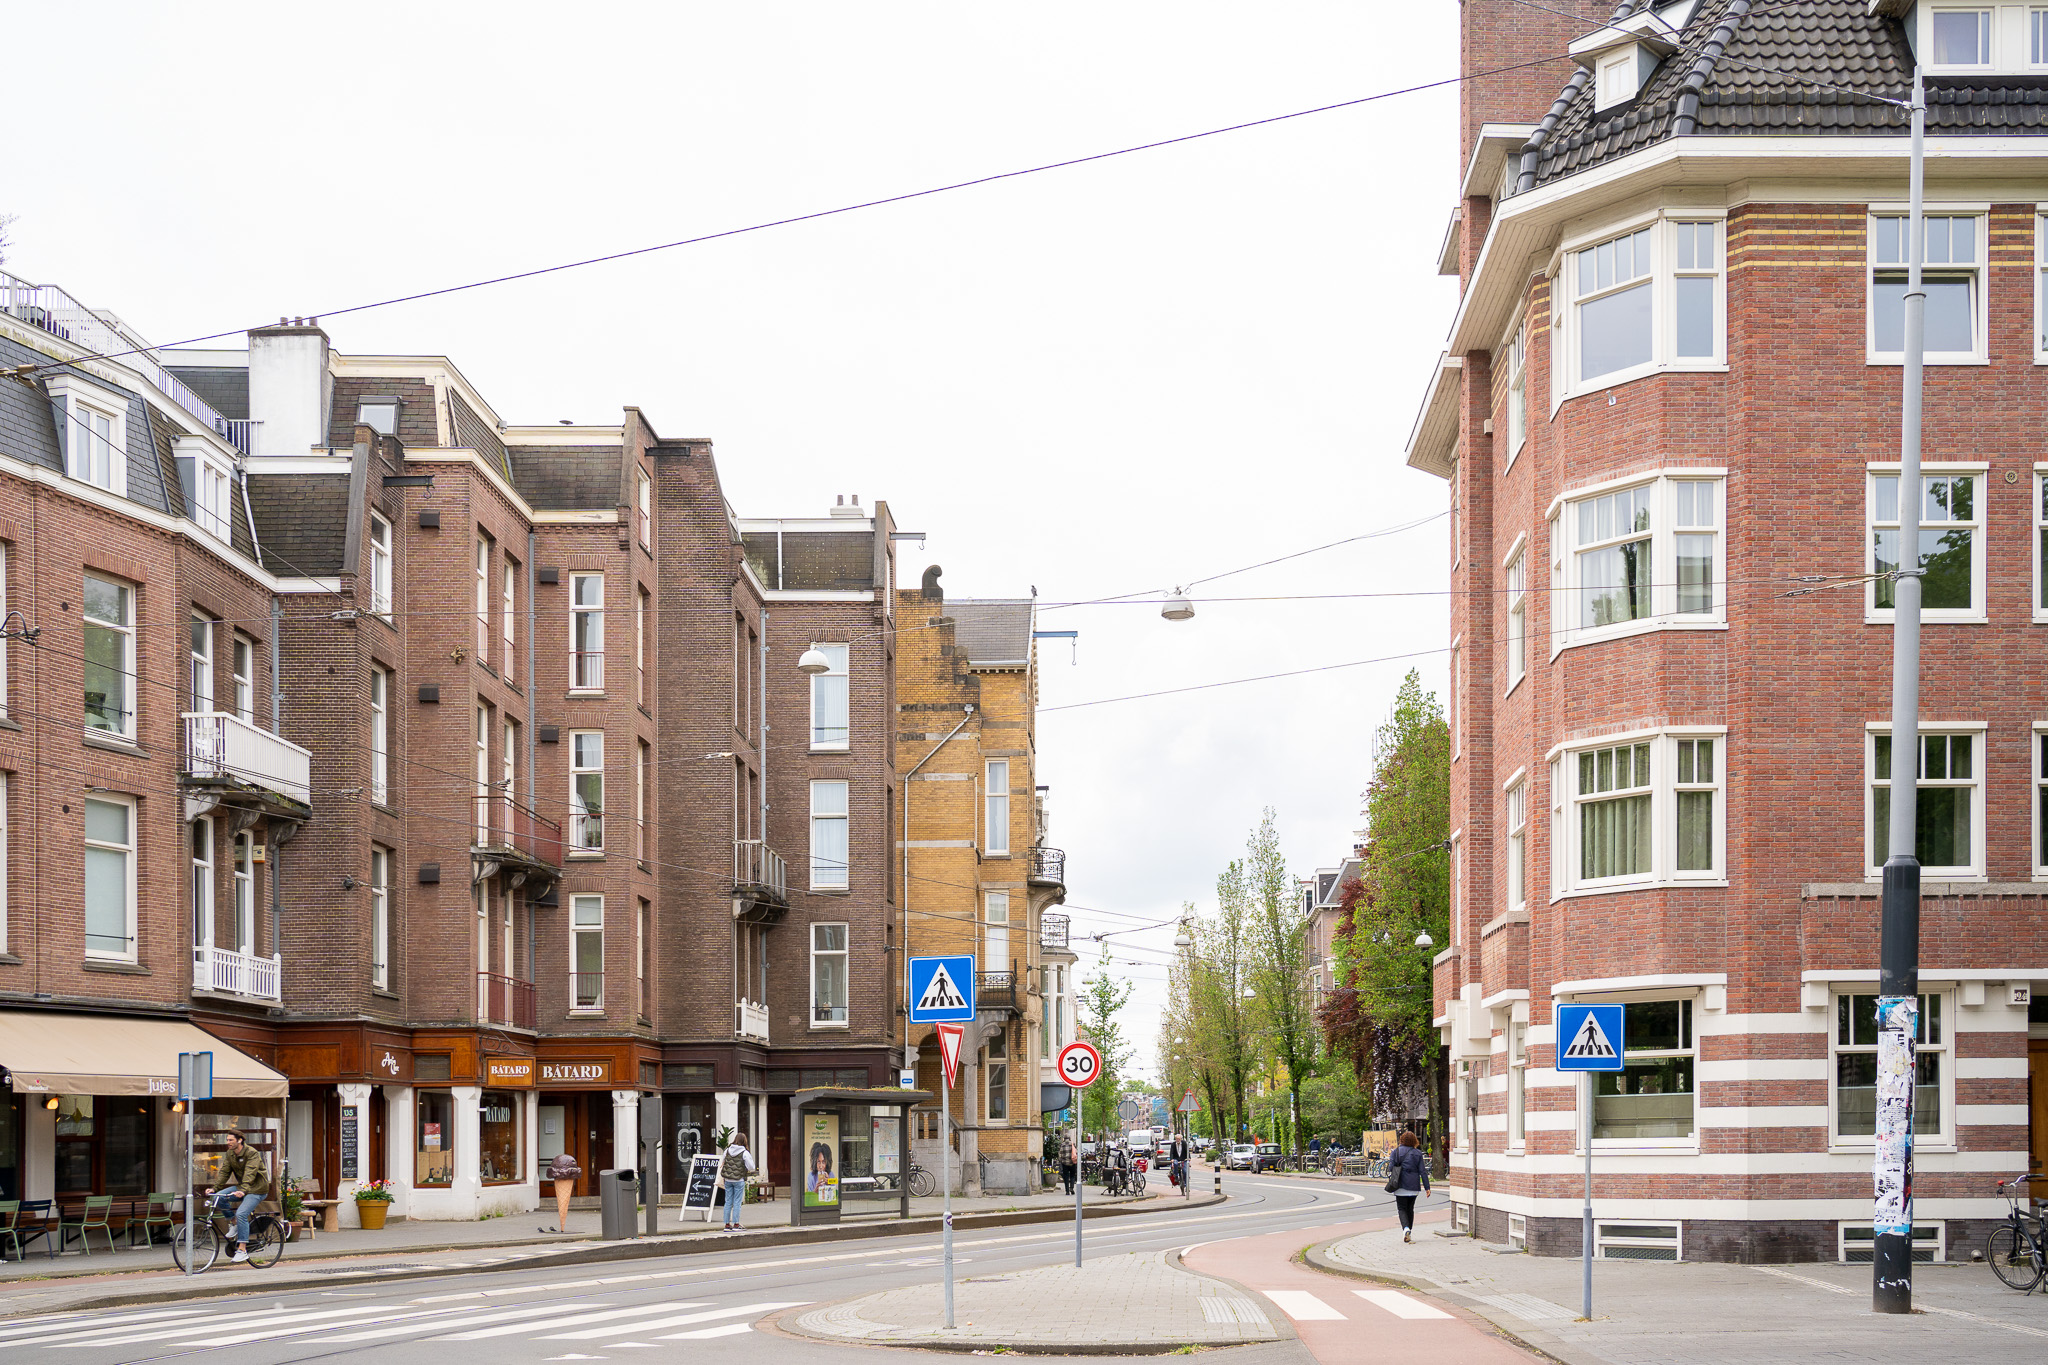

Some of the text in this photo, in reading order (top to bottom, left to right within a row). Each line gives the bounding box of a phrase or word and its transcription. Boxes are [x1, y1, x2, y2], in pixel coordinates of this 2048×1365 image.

[490, 1064, 530, 1074] BÂTARD
[542, 1063, 603, 1078] BÂTARD
[1065, 1056, 1093, 1073] 30
[148, 1078, 176, 1094] Jules
[701, 1166, 710, 1174] IS
